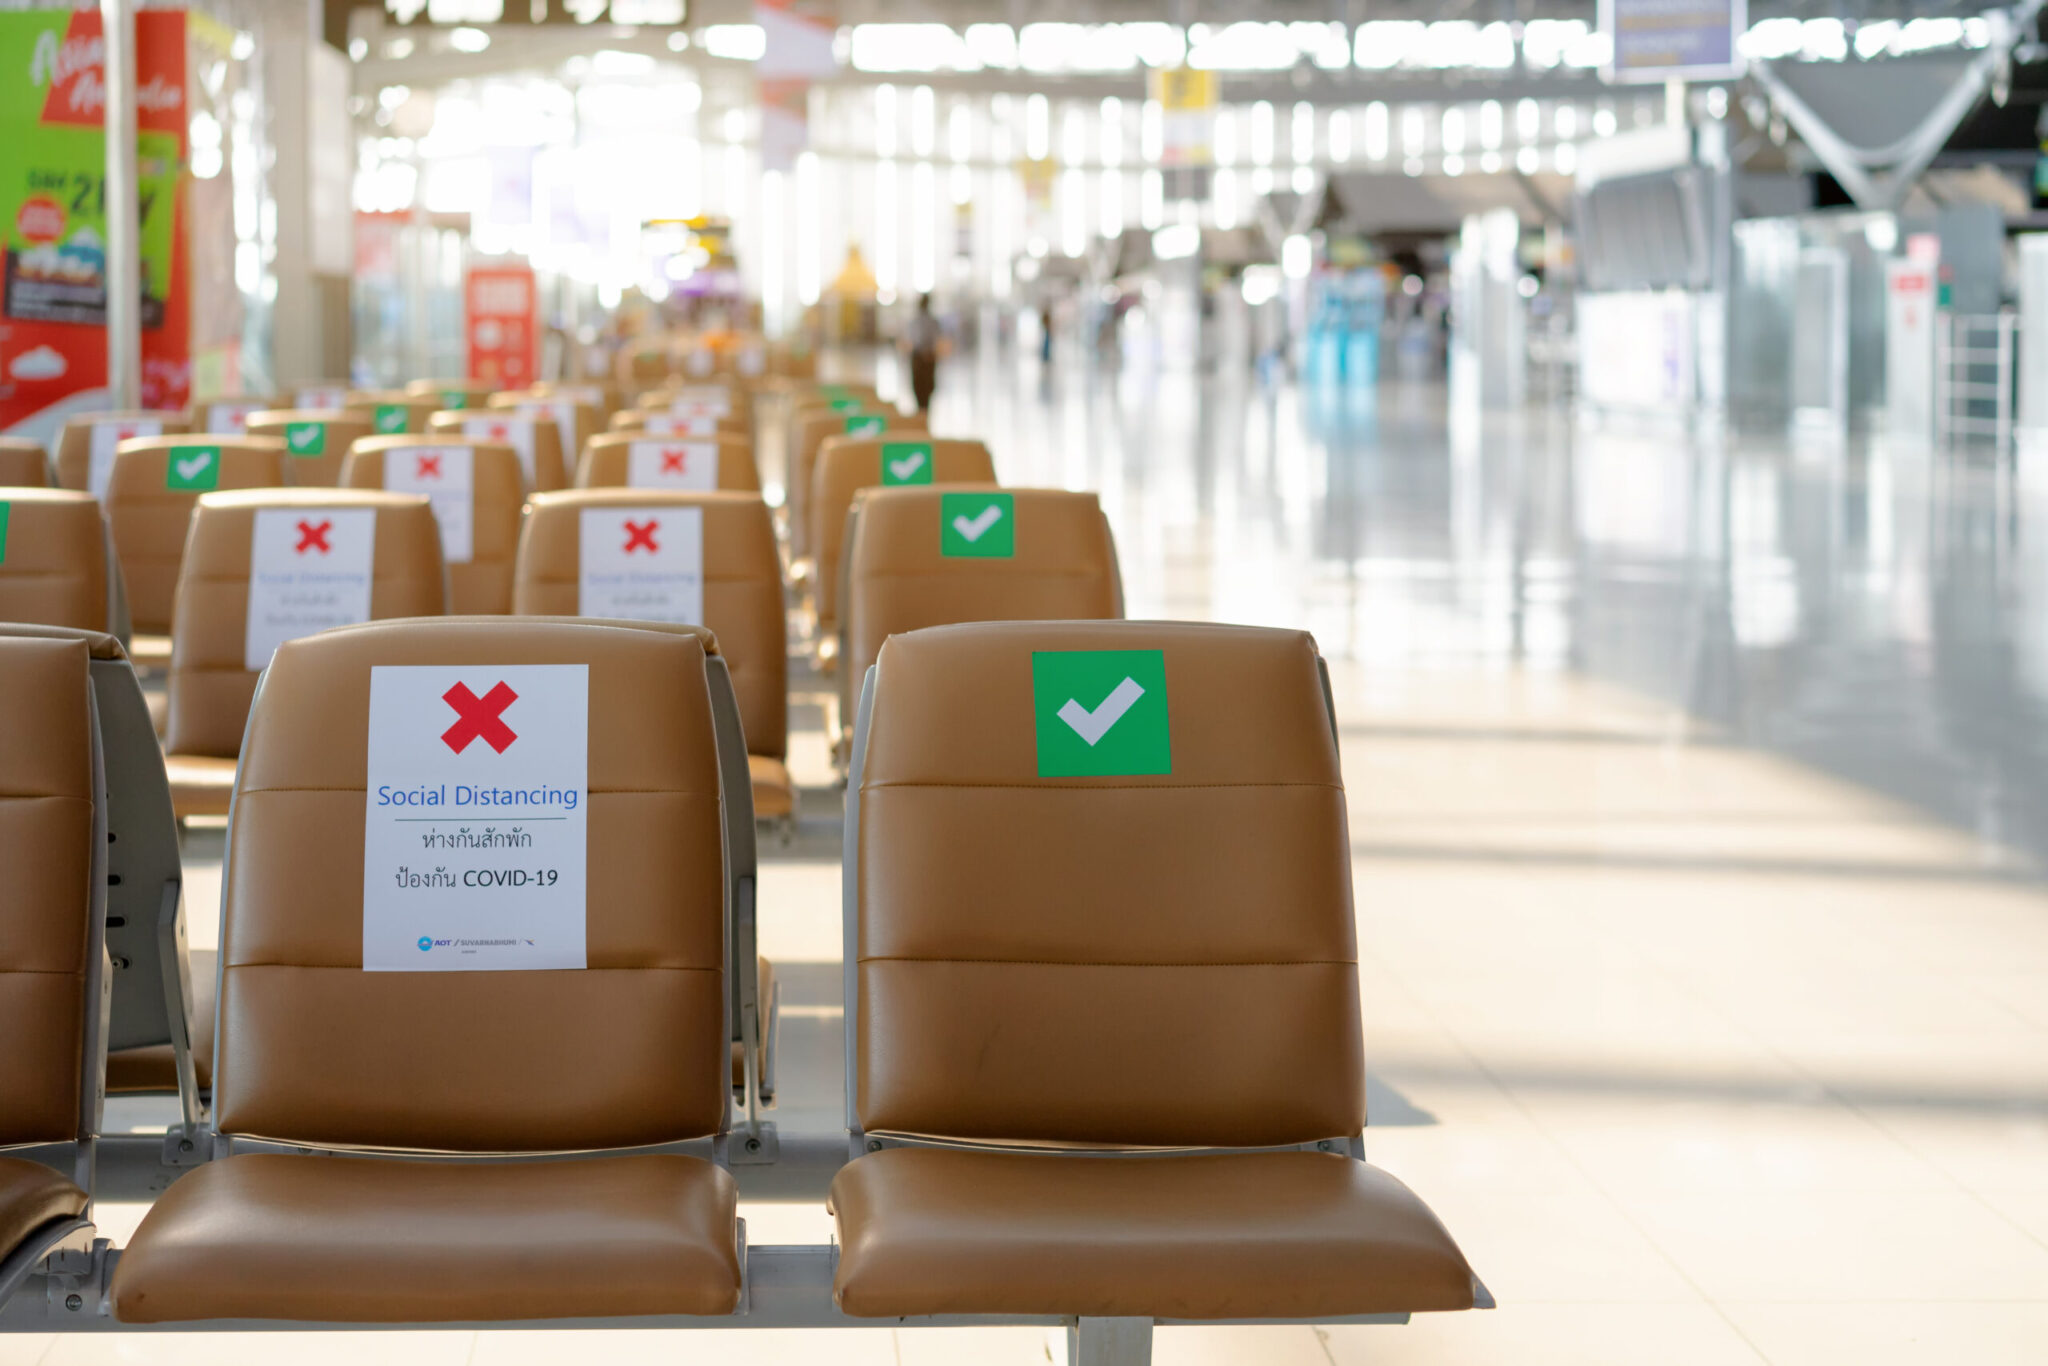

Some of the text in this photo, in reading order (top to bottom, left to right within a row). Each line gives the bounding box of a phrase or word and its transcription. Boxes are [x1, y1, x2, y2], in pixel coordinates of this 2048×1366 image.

[377, 784, 579, 810] Social Distancing
[422, 826, 532, 849] ห่างกันสักพัก
[395, 865, 558, 889] ป้องกัน COVID-19
[433, 939, 452, 947] AOT
